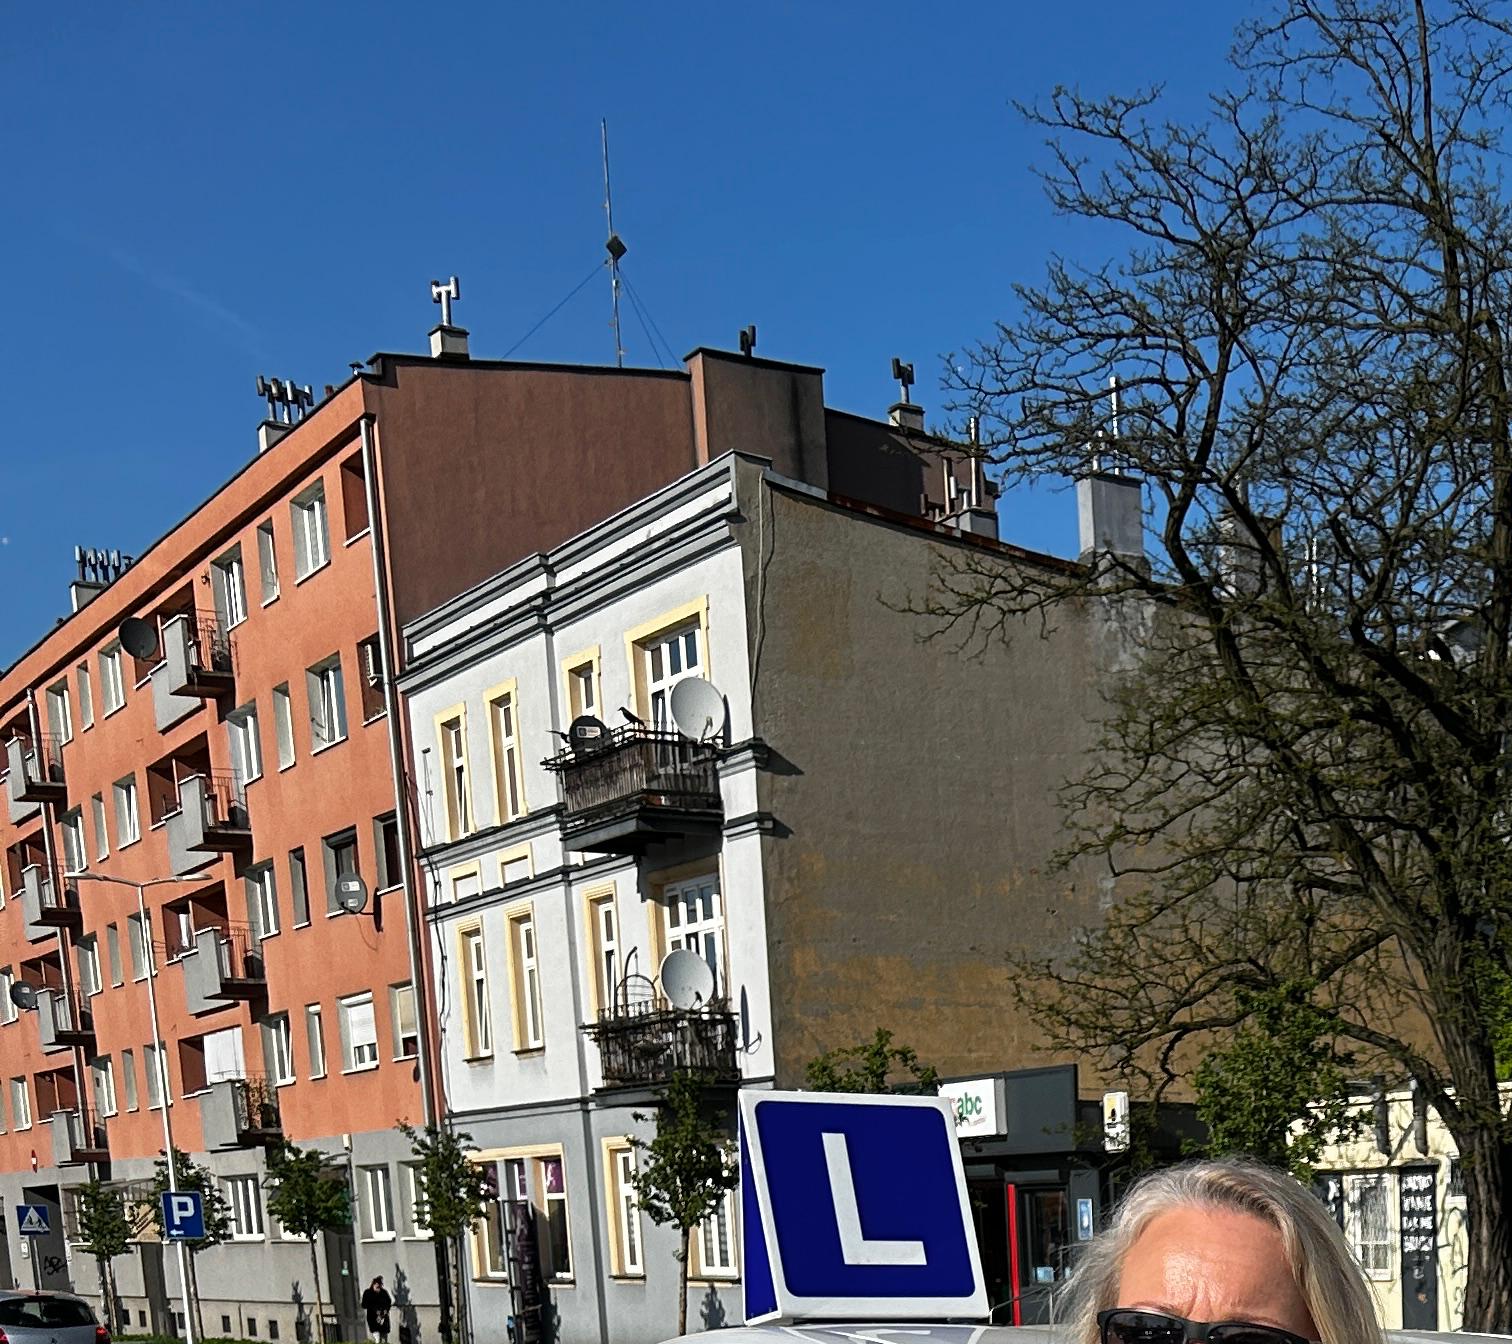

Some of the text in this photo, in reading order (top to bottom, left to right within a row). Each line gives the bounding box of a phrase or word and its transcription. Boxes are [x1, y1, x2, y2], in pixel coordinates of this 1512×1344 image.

[957, 1092, 982, 1117] abc
[172, 1195, 195, 1225] P
[821, 1132, 928, 1266] L
